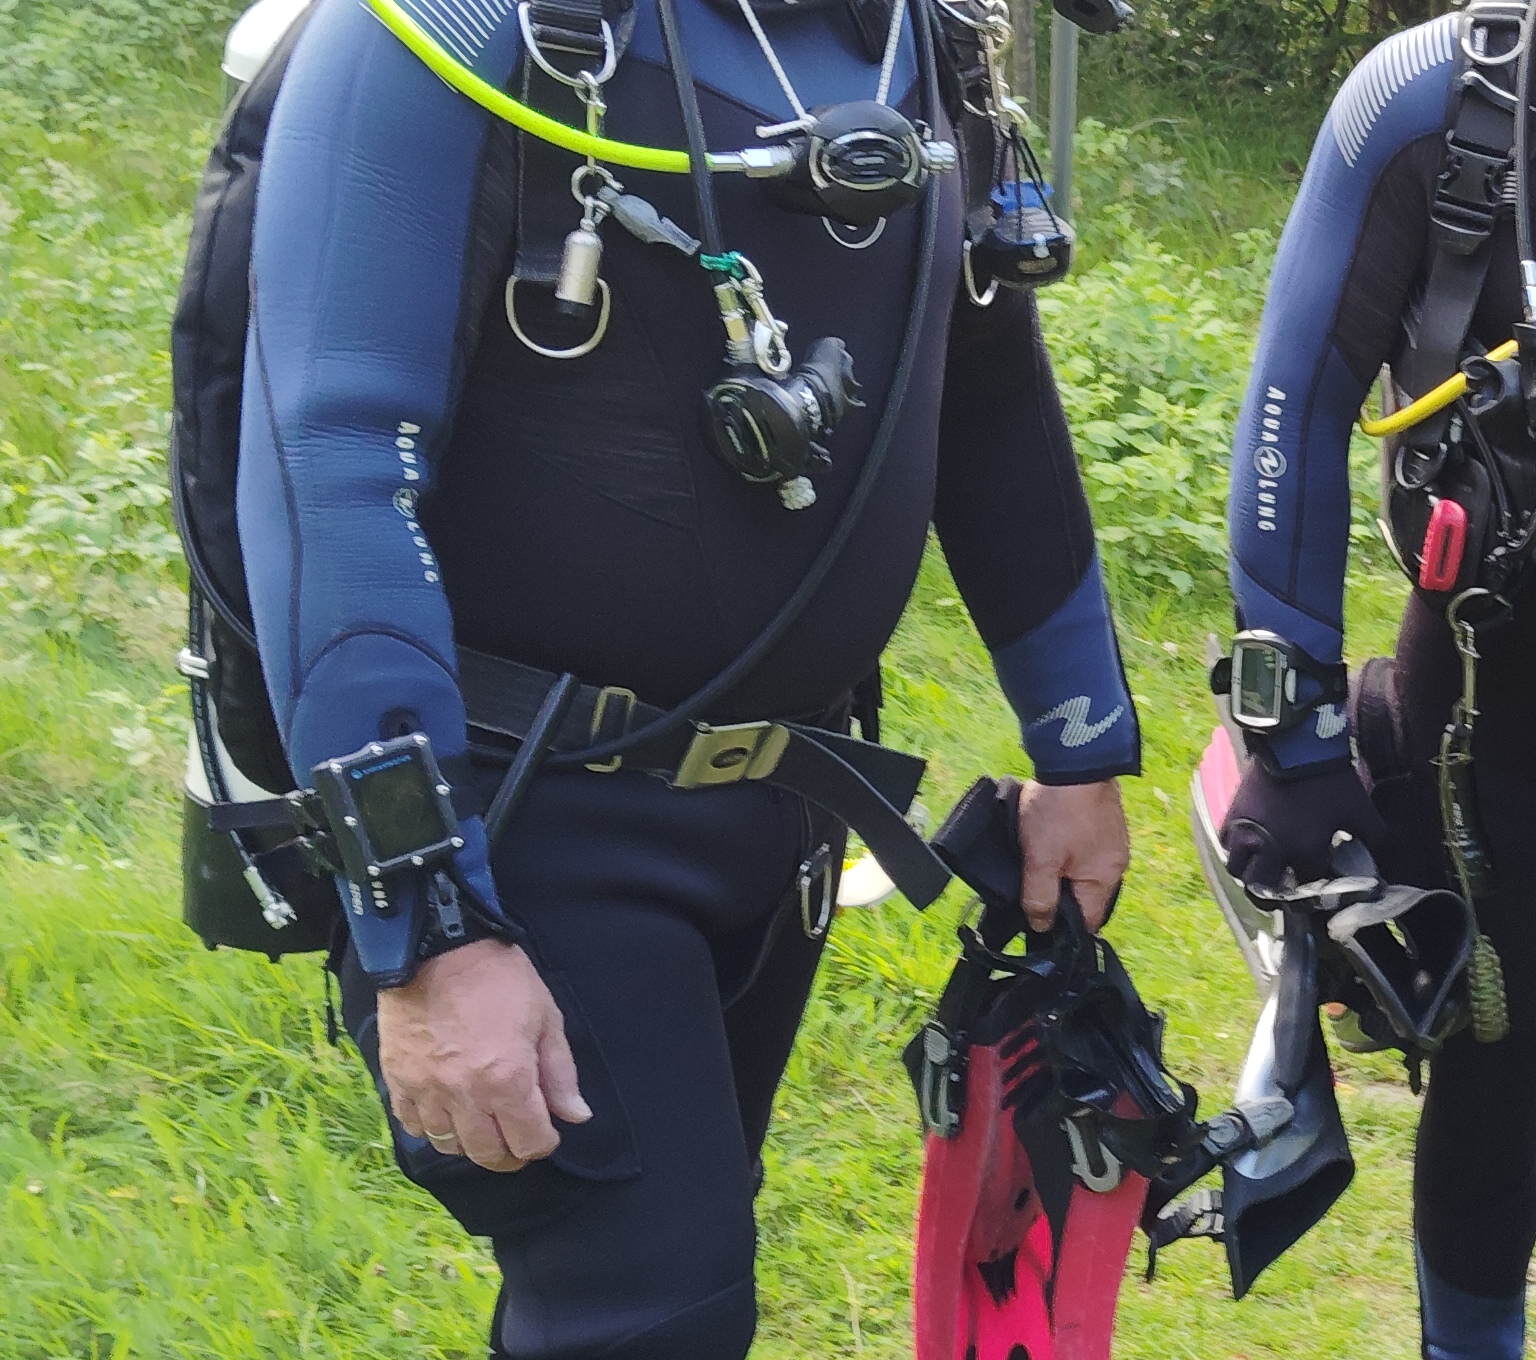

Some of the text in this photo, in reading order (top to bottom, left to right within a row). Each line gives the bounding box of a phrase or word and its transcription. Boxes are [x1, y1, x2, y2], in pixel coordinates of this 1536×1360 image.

[394, 420, 439, 583] AQUA LUNG
[1257, 385, 1287, 532] AQUA LUNG
